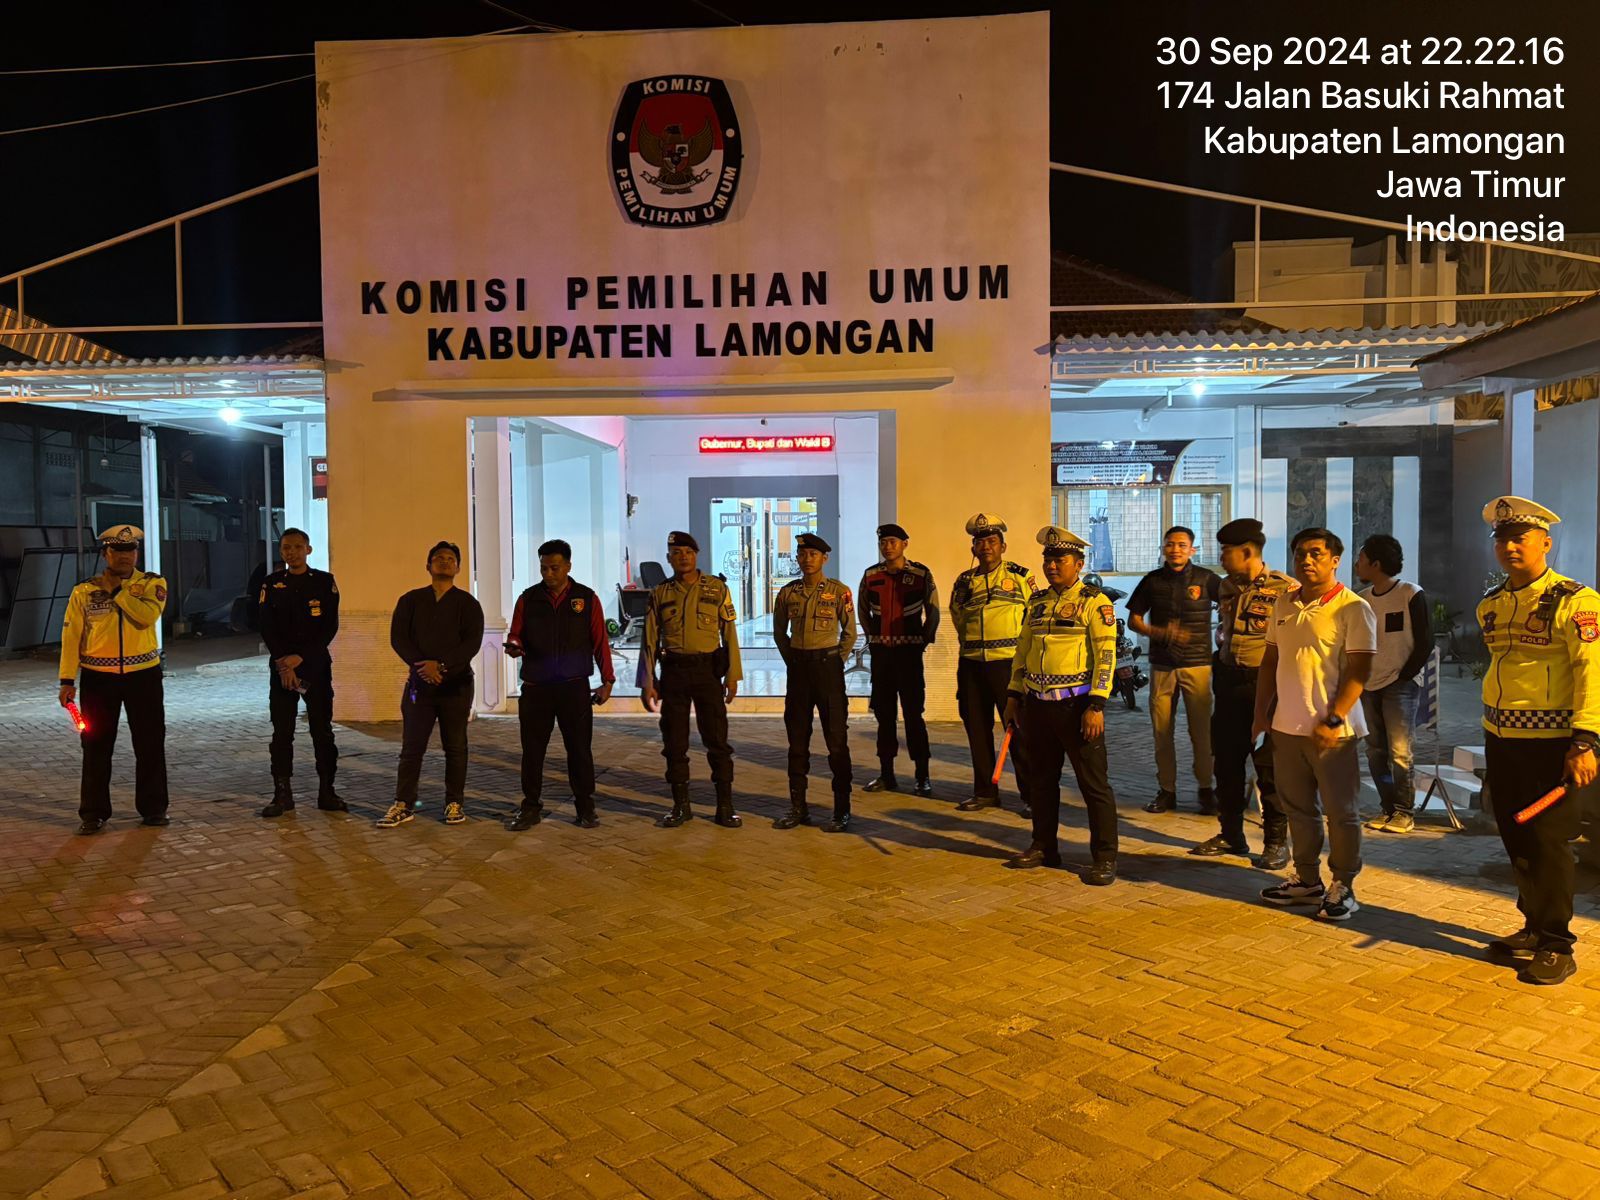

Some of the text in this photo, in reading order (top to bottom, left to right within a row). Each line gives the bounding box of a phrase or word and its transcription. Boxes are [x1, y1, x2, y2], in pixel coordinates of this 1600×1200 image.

[643, 79, 711, 95] KOMISI
[616, 167, 737, 223] PEMILIHAN UMUM
[361, 265, 1010, 315] KOMISI PEMILIHAN UMUM
[428, 319, 934, 361] KABUPATEN LAMONGAN
[746, 437, 774, 450] Bupati
[776, 437, 793, 448] dan
[794, 437, 820, 448] Wakil
[1252, 595, 1277, 604] POLRI
[1521, 635, 1547, 645] POLRI
[1097, 649, 1114, 690] POLISI
